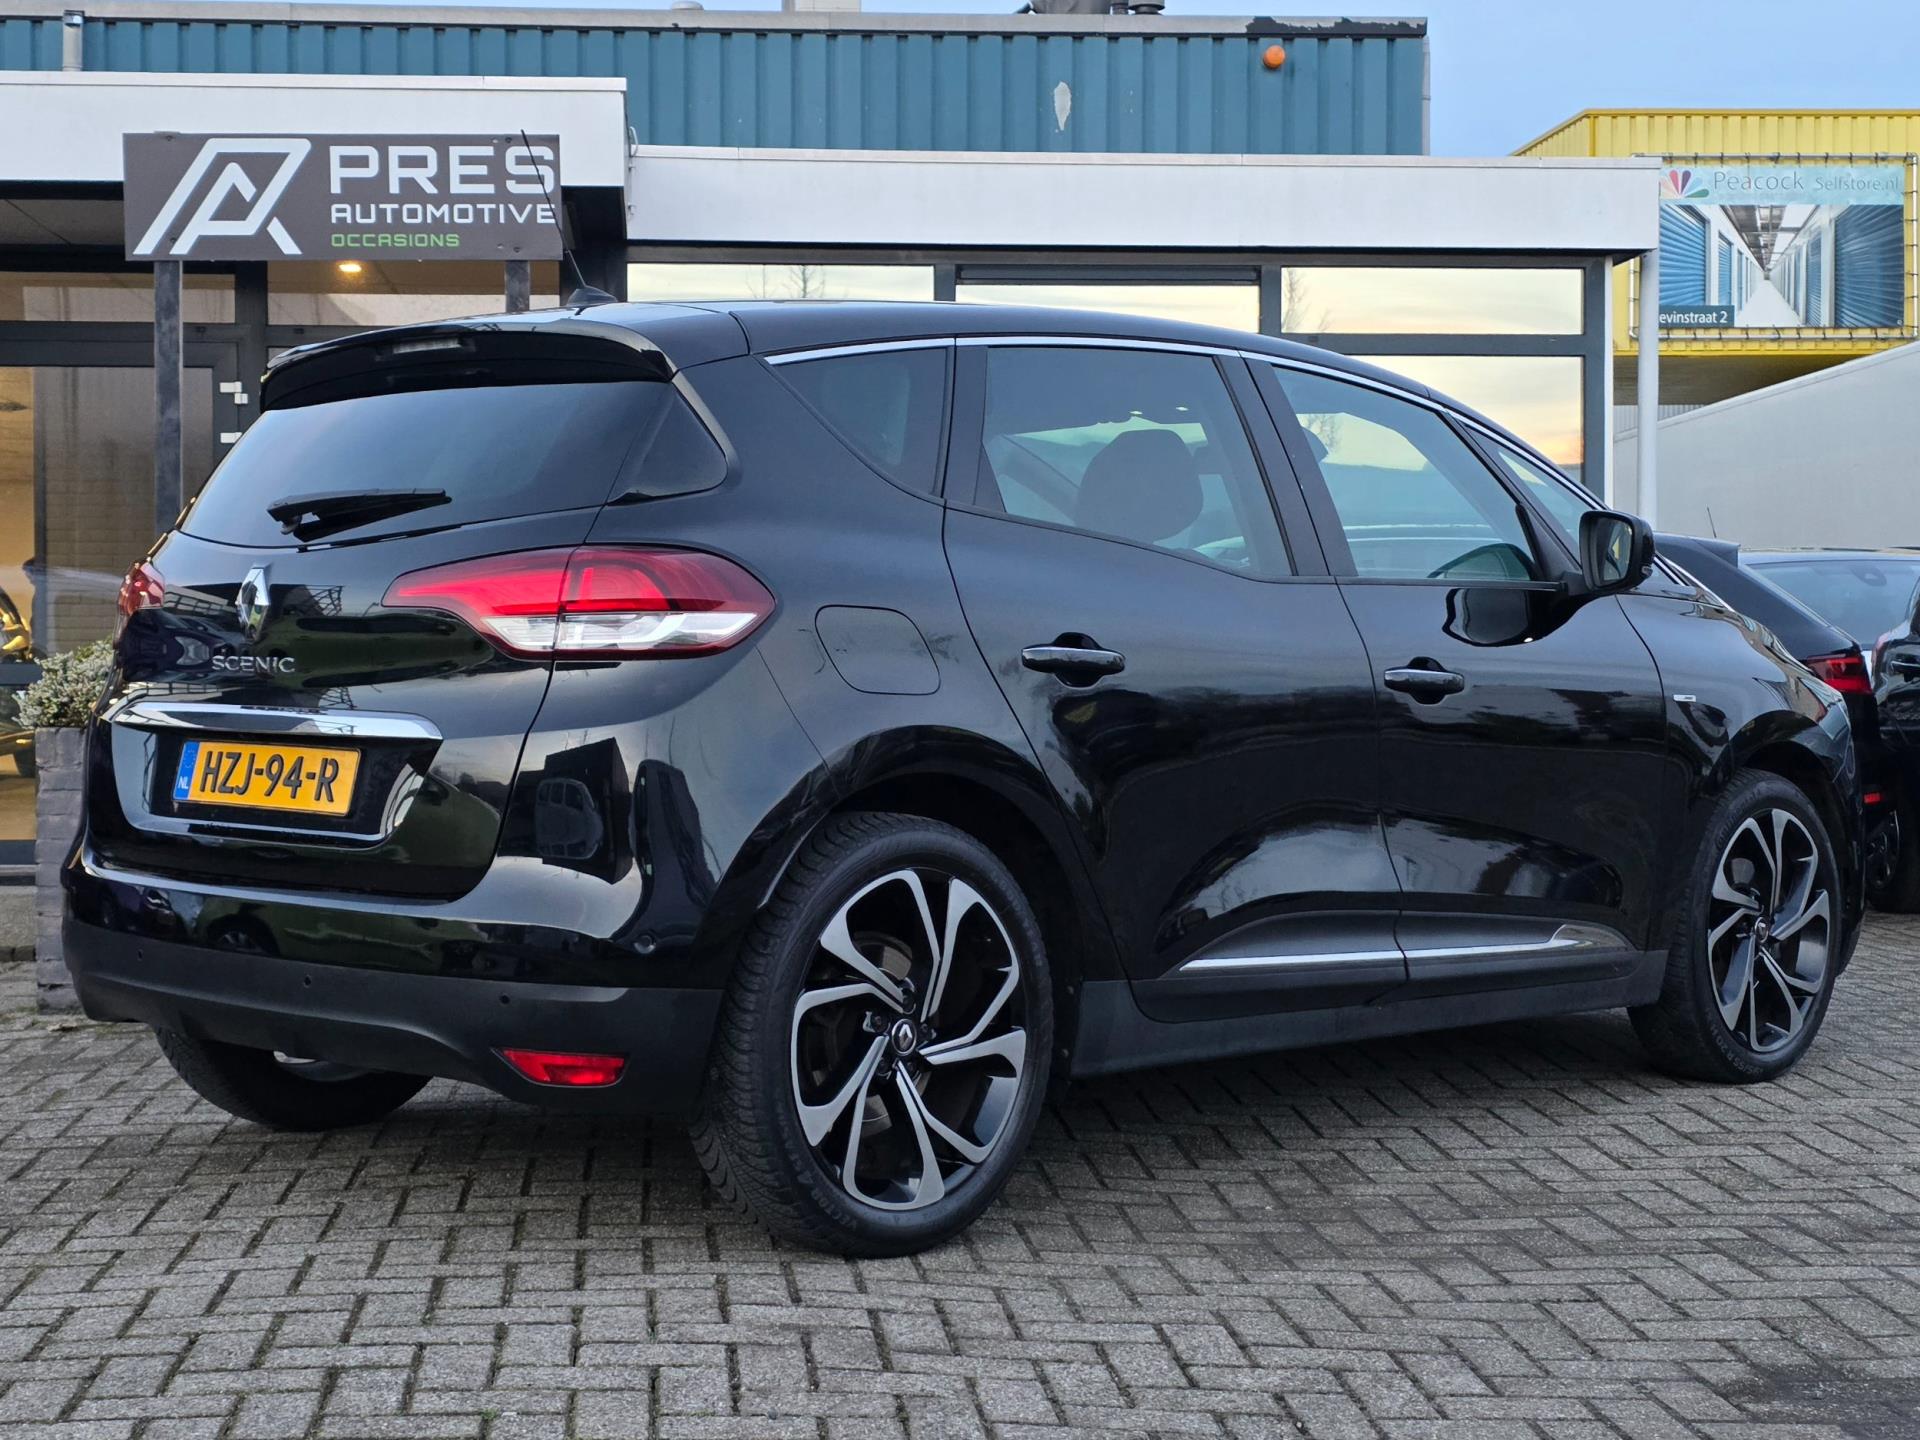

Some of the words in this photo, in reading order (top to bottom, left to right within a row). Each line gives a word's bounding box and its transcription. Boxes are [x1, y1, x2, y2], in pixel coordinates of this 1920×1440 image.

[329, 145, 555, 194] PRES
[1714, 171, 1804, 190] Peacock
[1815, 176, 1899, 191] Selfstore.nl
[331, 203, 556, 224] AUTOMOTIVE
[331, 233, 460, 247] OCCASIONS
[1720, 311, 1728, 324] 2
[212, 655, 296, 673] SCENIC
[178, 776, 189, 790] NL
[200, 751, 339, 802] HZJ-94-R
